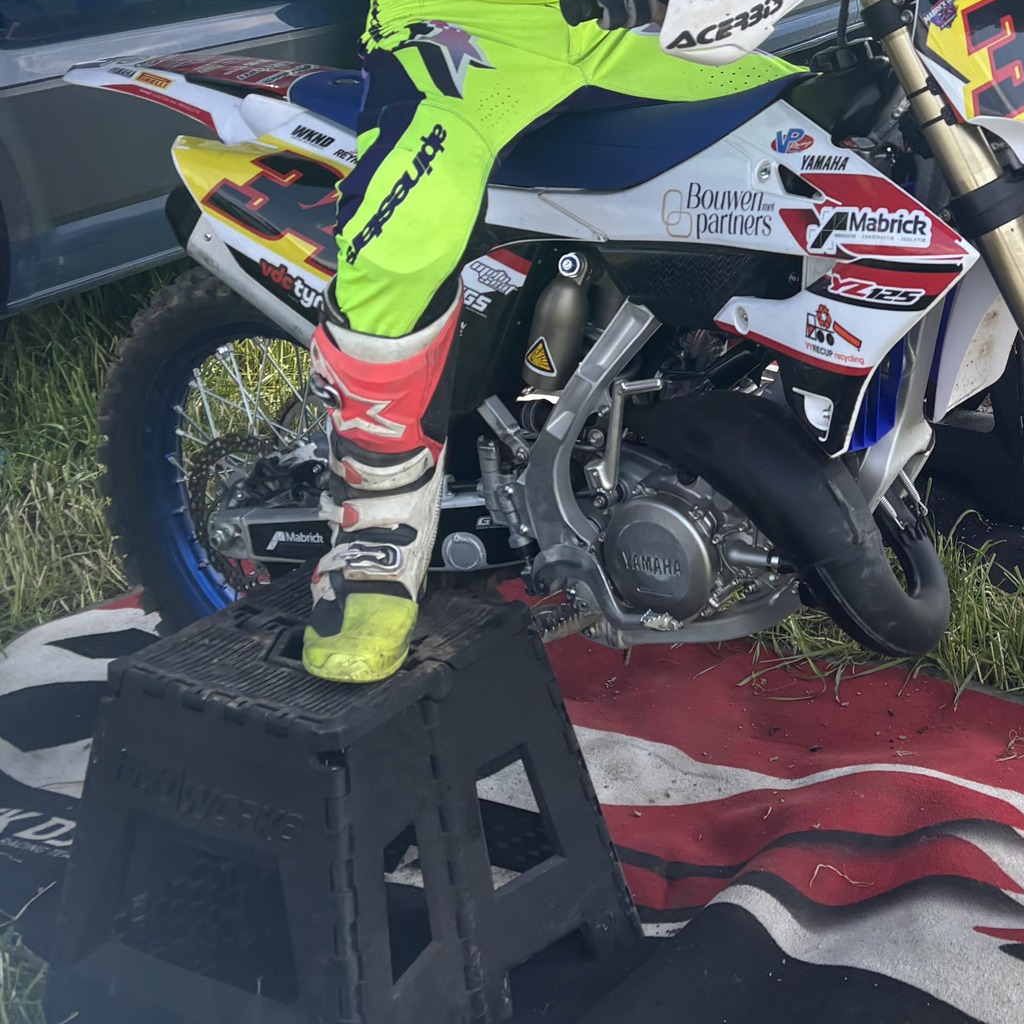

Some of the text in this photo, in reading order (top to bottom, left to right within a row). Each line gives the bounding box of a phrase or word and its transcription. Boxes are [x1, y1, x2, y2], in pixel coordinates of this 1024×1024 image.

[135, 72, 174, 91] PIRELLI
[290, 124, 336, 149] WKND
[775, 128, 805, 154] VP
[800, 154, 850, 171] YAMAHA
[686, 182, 764, 212] Bouwen
[696, 211, 773, 240] partners
[850, 212, 927, 236] Mabrick
[830, 275, 923, 304] YZ125
[804, 342, 865, 365] VYRECUP recycling
[285, 531, 325, 545] Mabrick
[621, 550, 683, 577] YAMAHA
